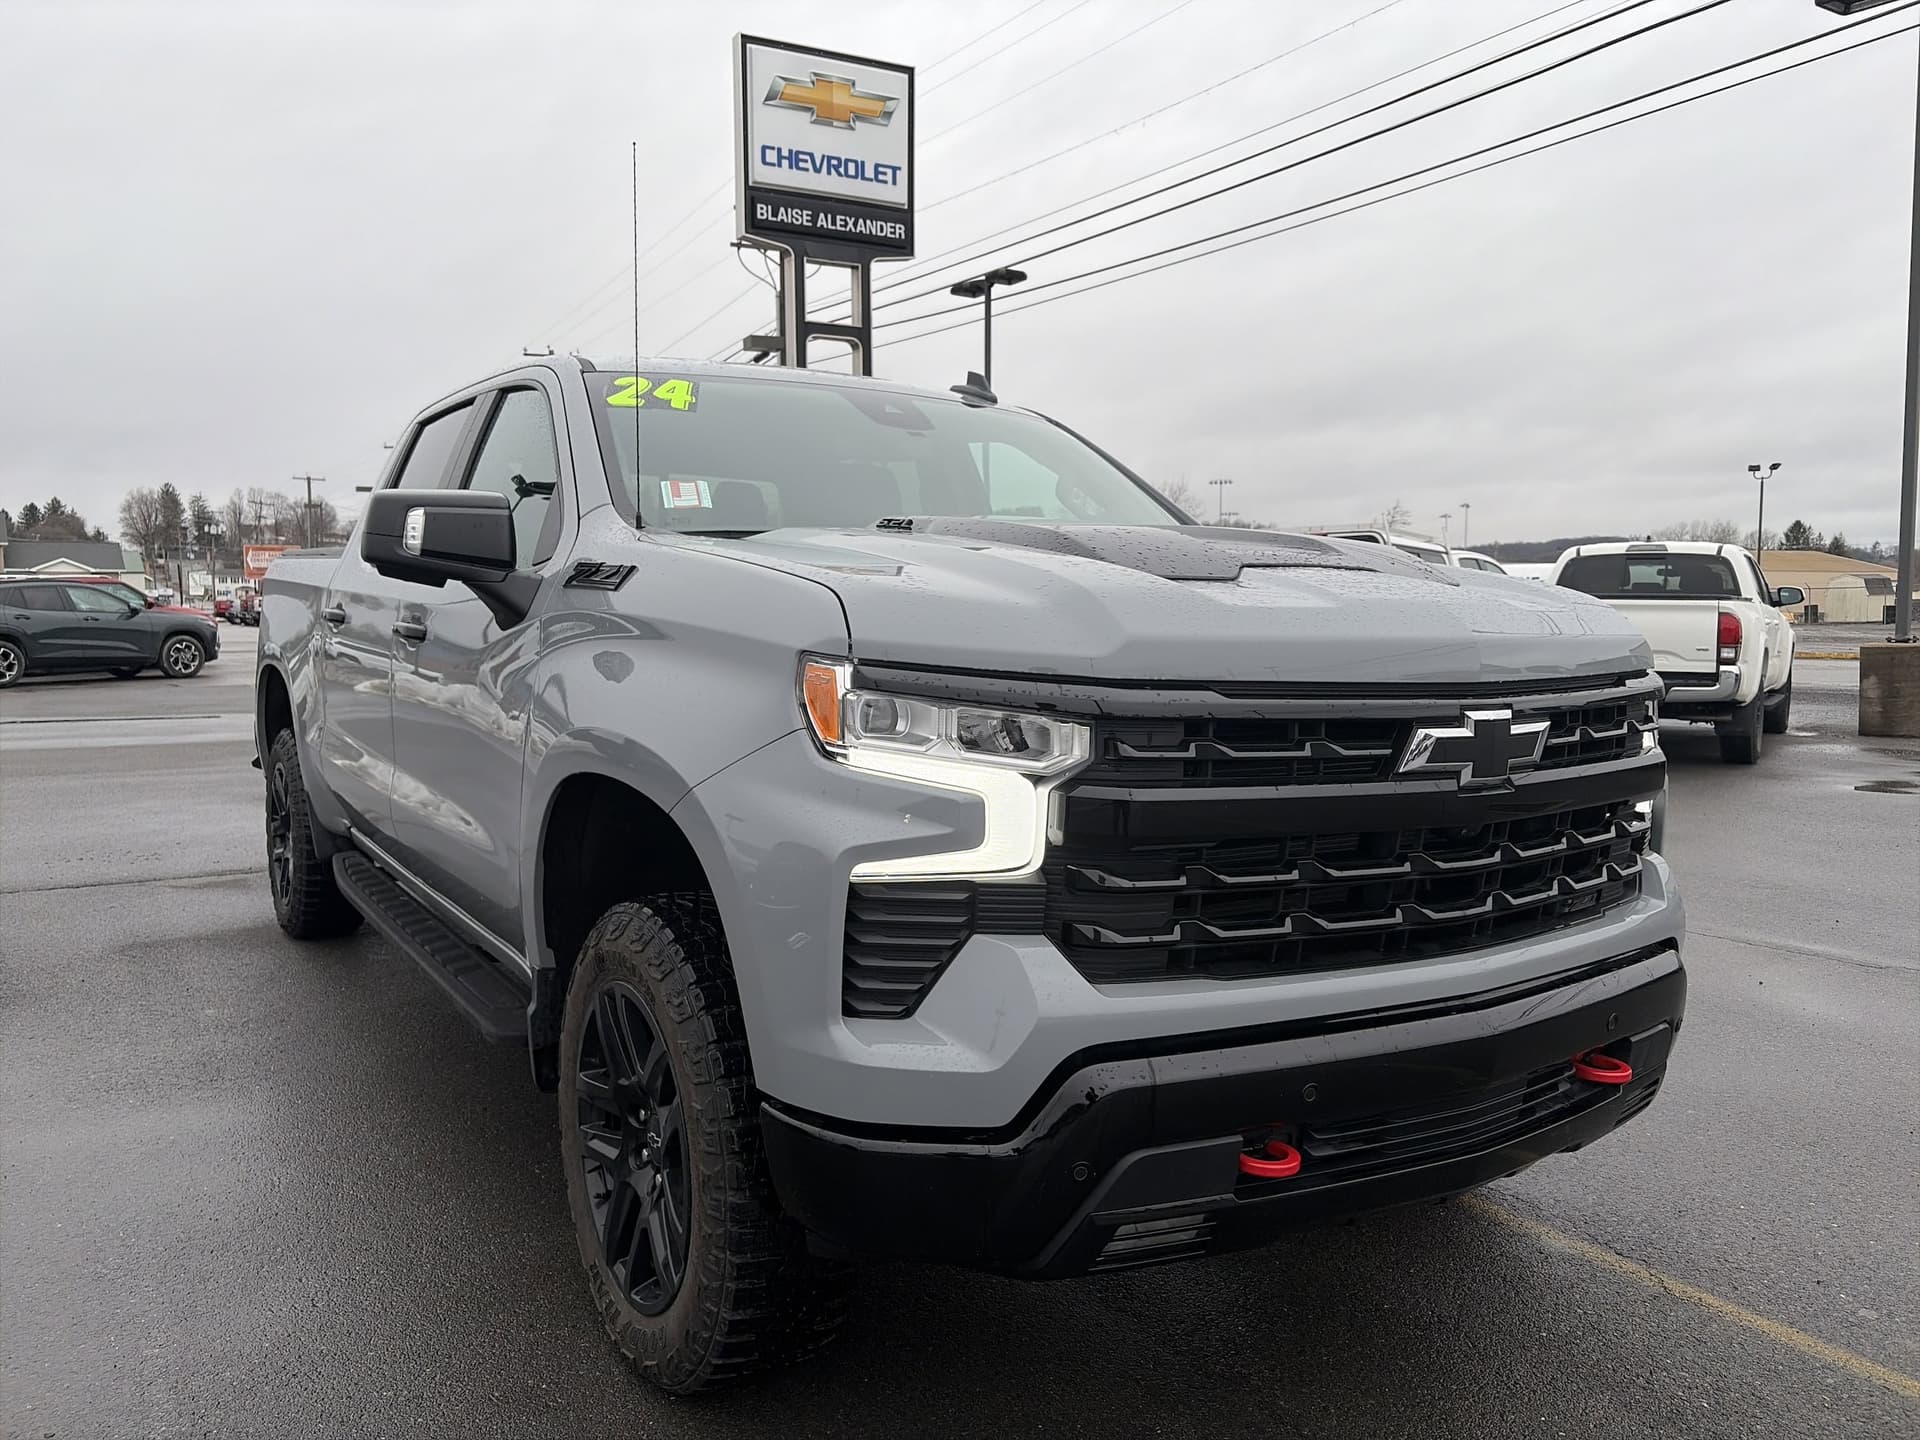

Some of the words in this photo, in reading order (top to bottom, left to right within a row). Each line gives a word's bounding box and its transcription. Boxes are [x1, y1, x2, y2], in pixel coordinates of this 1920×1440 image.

[760, 144, 902, 186] CHEVROLET
[756, 203, 813, 226] BLAISE
[817, 212, 906, 239] ALEXANDER
[606, 376, 696, 410] 24
